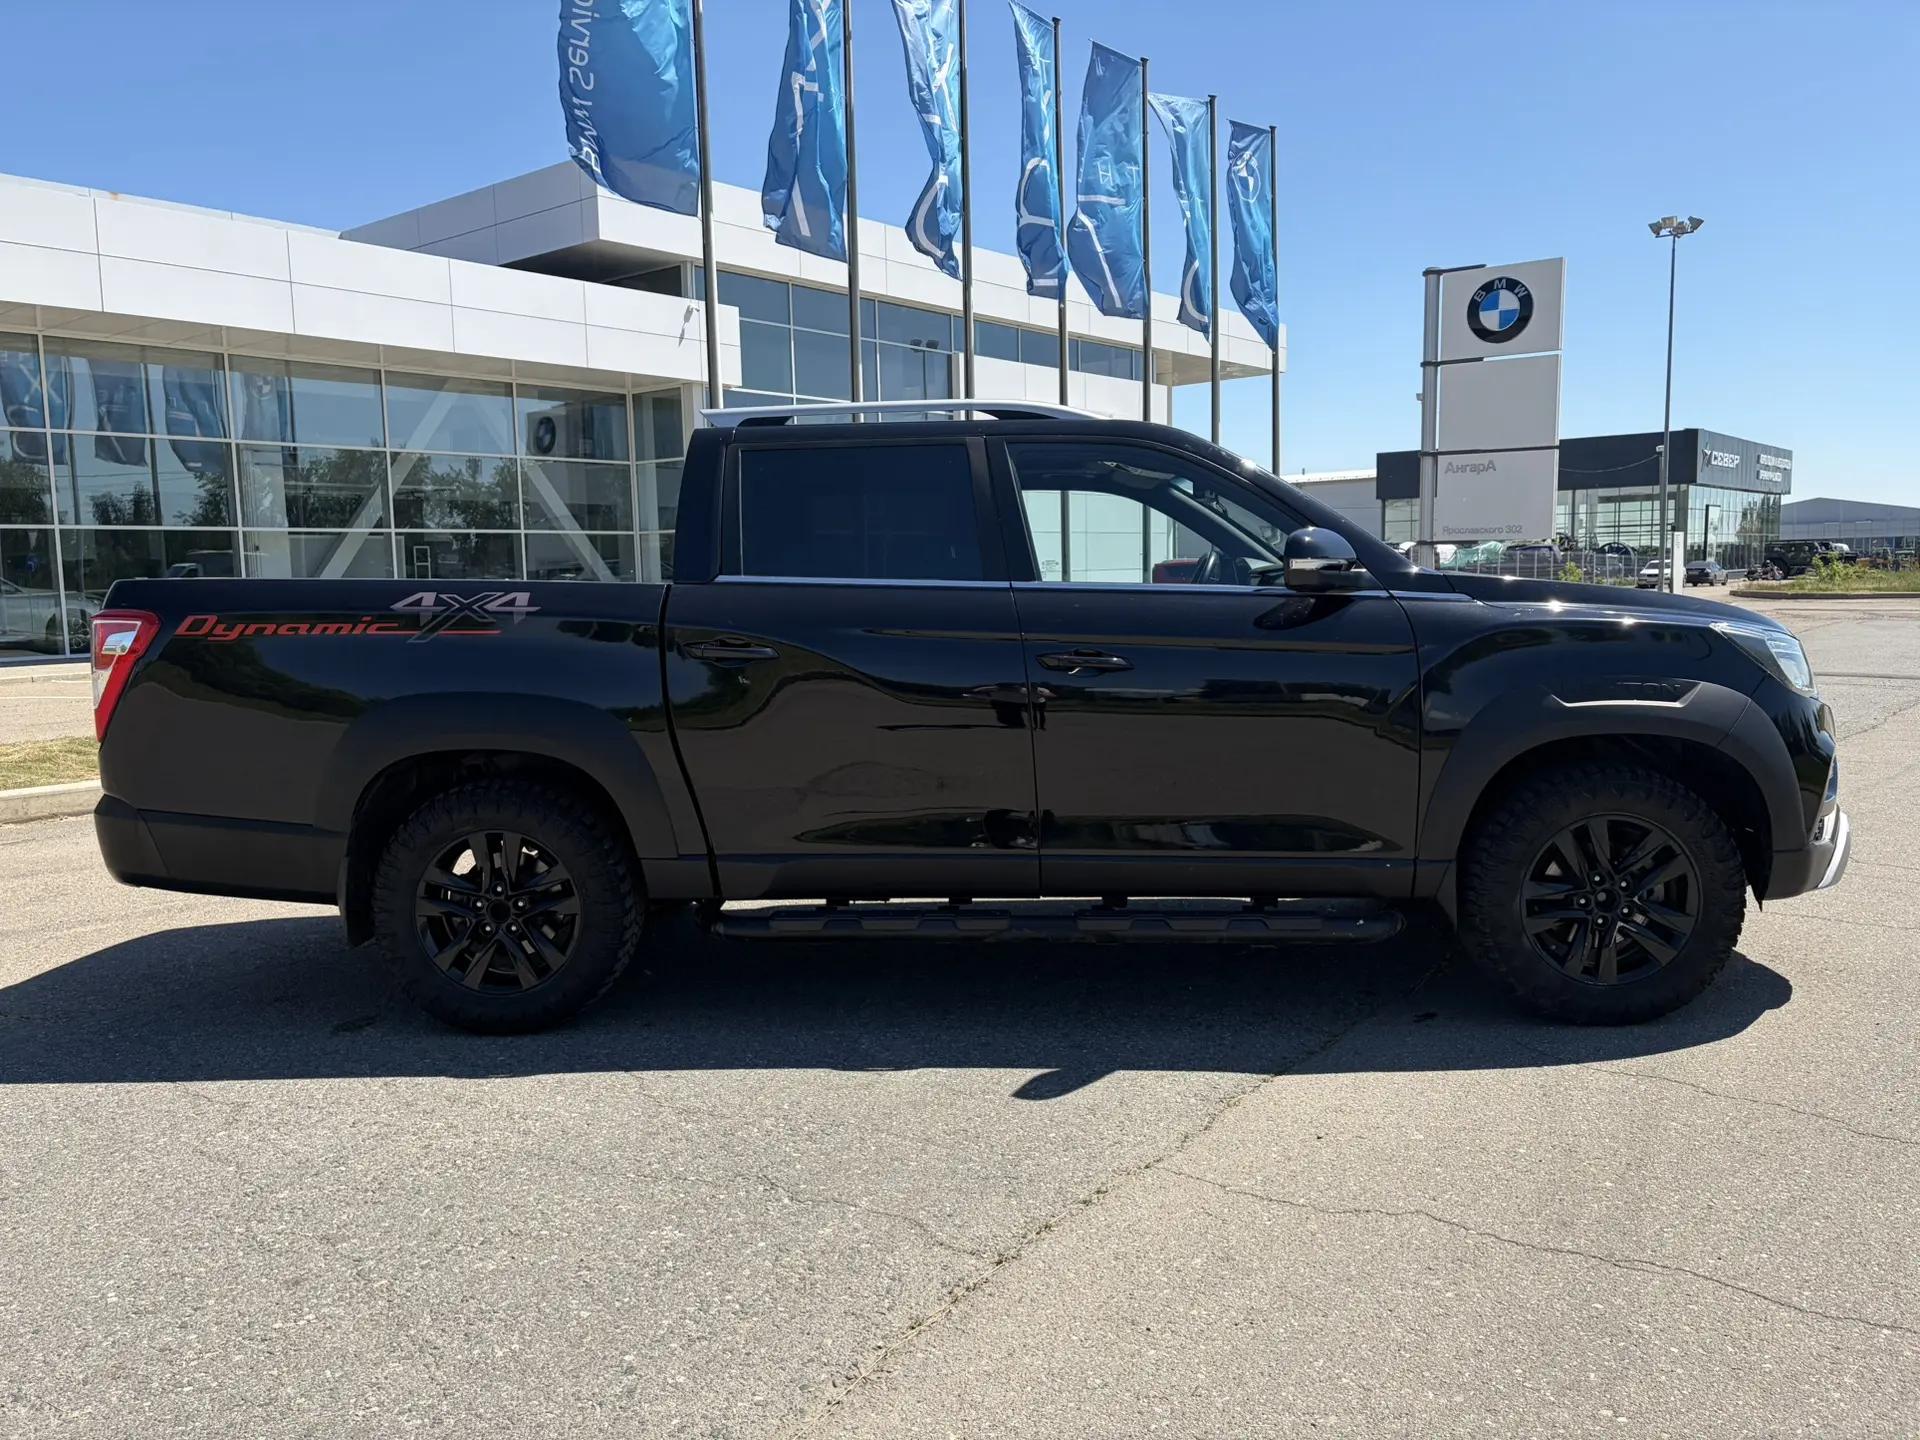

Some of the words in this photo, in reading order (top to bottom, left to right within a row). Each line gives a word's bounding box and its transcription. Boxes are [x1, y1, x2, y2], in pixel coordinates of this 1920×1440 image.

[1474, 278, 1529, 302] BMW
[1444, 459, 1497, 475] АнгарА
[1711, 451, 1740, 468] СЕВЕР
[1505, 524, 1523, 534] 302
[175, 614, 402, 641] Dynamic
